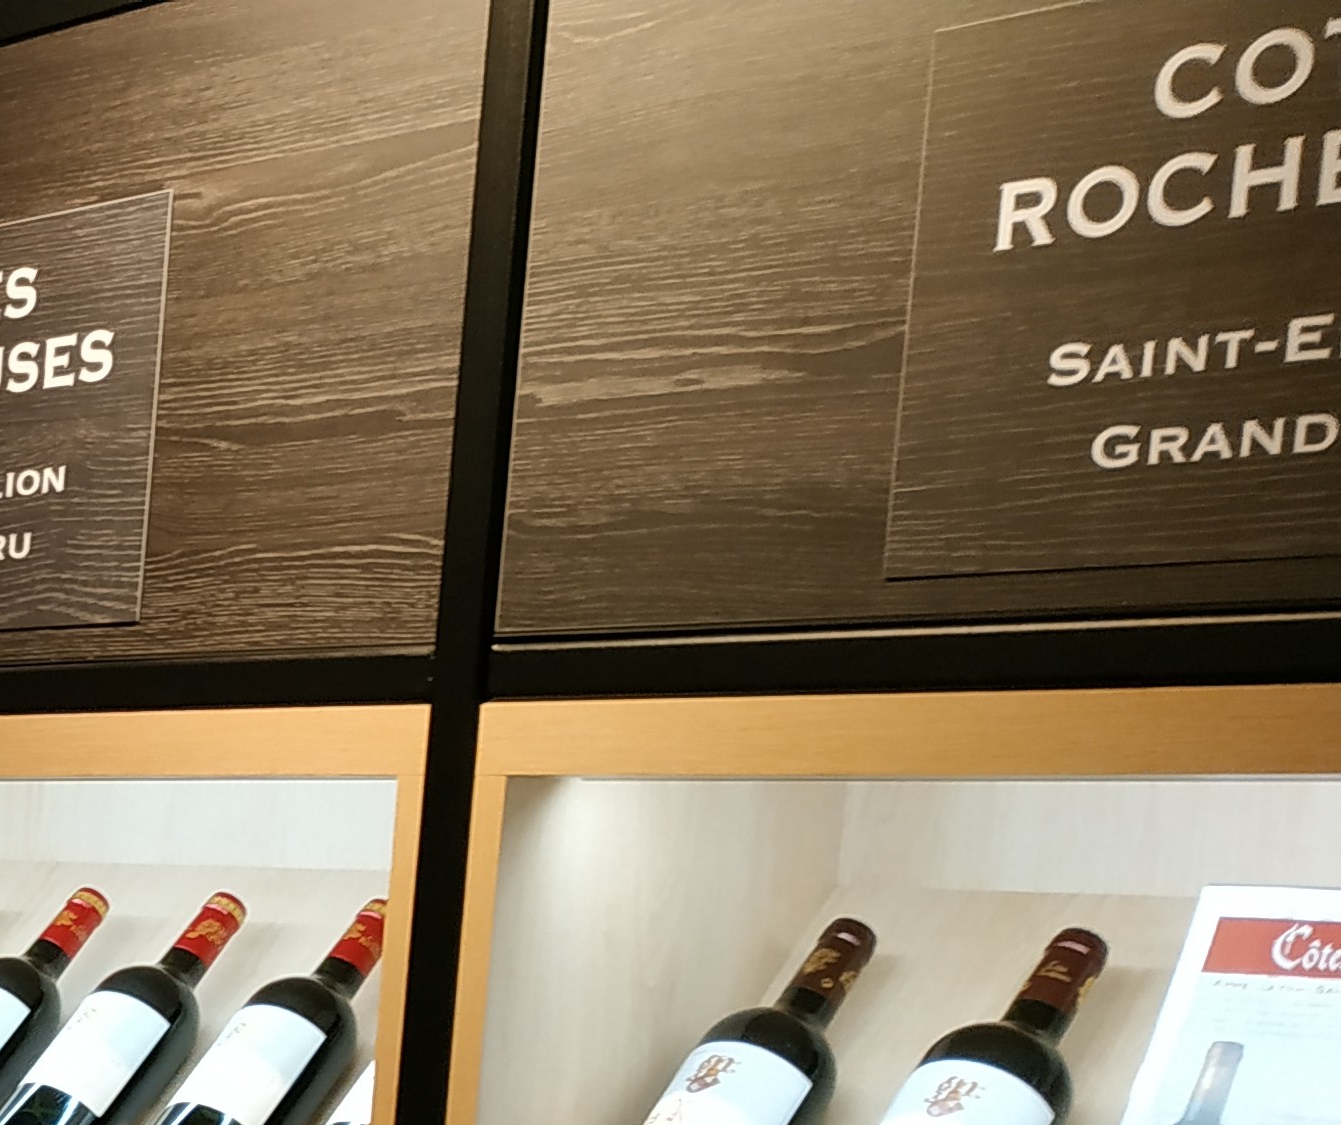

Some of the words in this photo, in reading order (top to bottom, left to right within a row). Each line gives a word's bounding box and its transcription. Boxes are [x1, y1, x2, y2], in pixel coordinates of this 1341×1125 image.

[1154, 17, 1341, 119] CO
[1047, 313, 1341, 387] SAINT-E
[1090, 413, 1341, 469] GRAND
[1272, 922, 1341, 972] Côte
